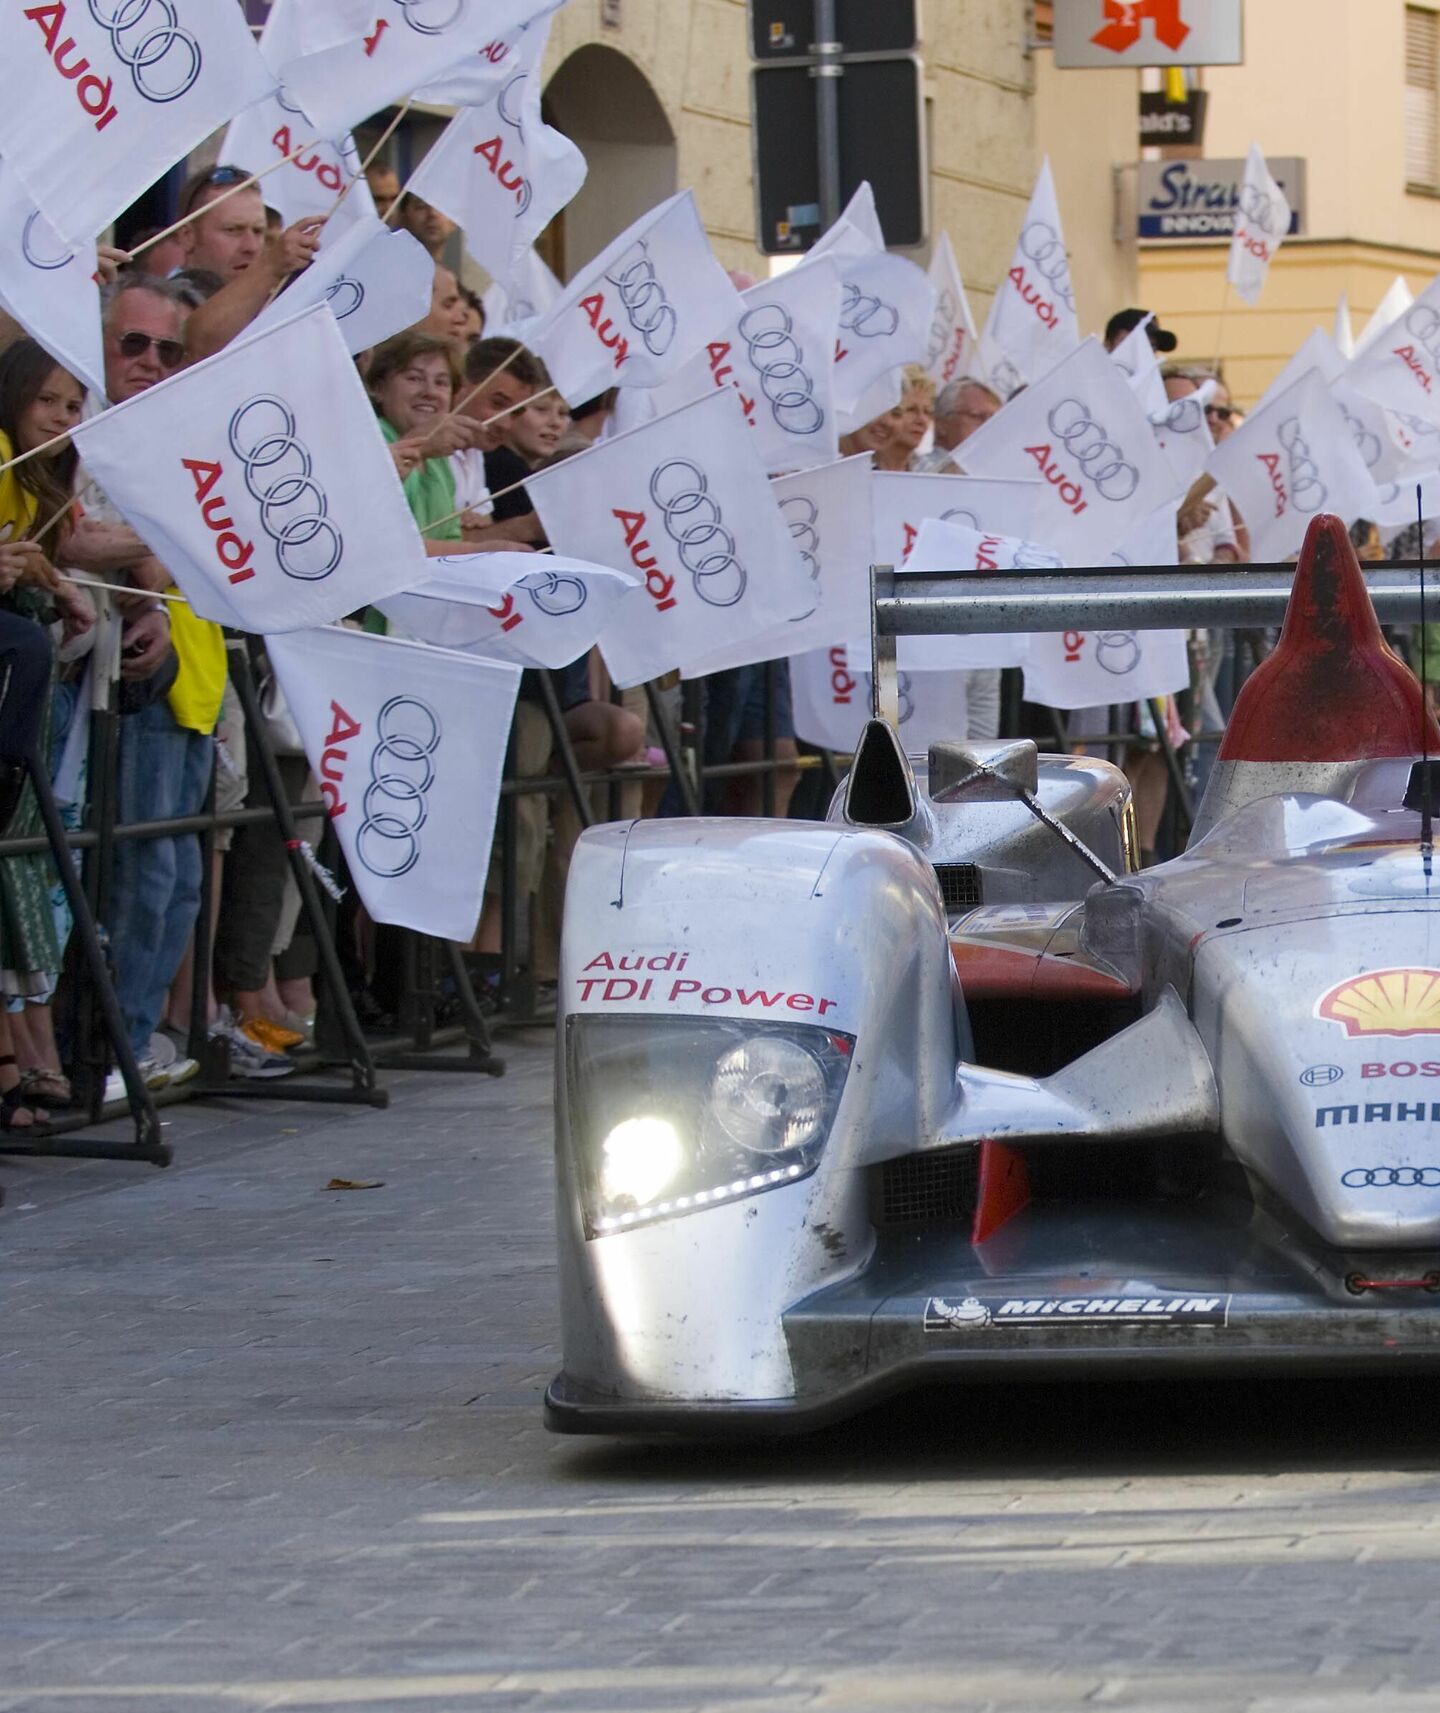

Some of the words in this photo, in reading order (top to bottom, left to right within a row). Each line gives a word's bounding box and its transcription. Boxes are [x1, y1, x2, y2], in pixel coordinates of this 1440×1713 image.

[23, 1, 118, 132] Audi
[1008, 265, 1058, 330] Audi
[1023, 444, 1088, 515] Audi
[182, 458, 255, 585] Audi
[612, 508, 678, 613] Audi
[829, 646, 856, 704] udi
[320, 699, 362, 818] Aud
[583, 951, 690, 972] Audi
[576, 979, 653, 1001] TDI
[668, 979, 838, 1016] Power
[998, 1299, 1220, 1315] MICHELIN
